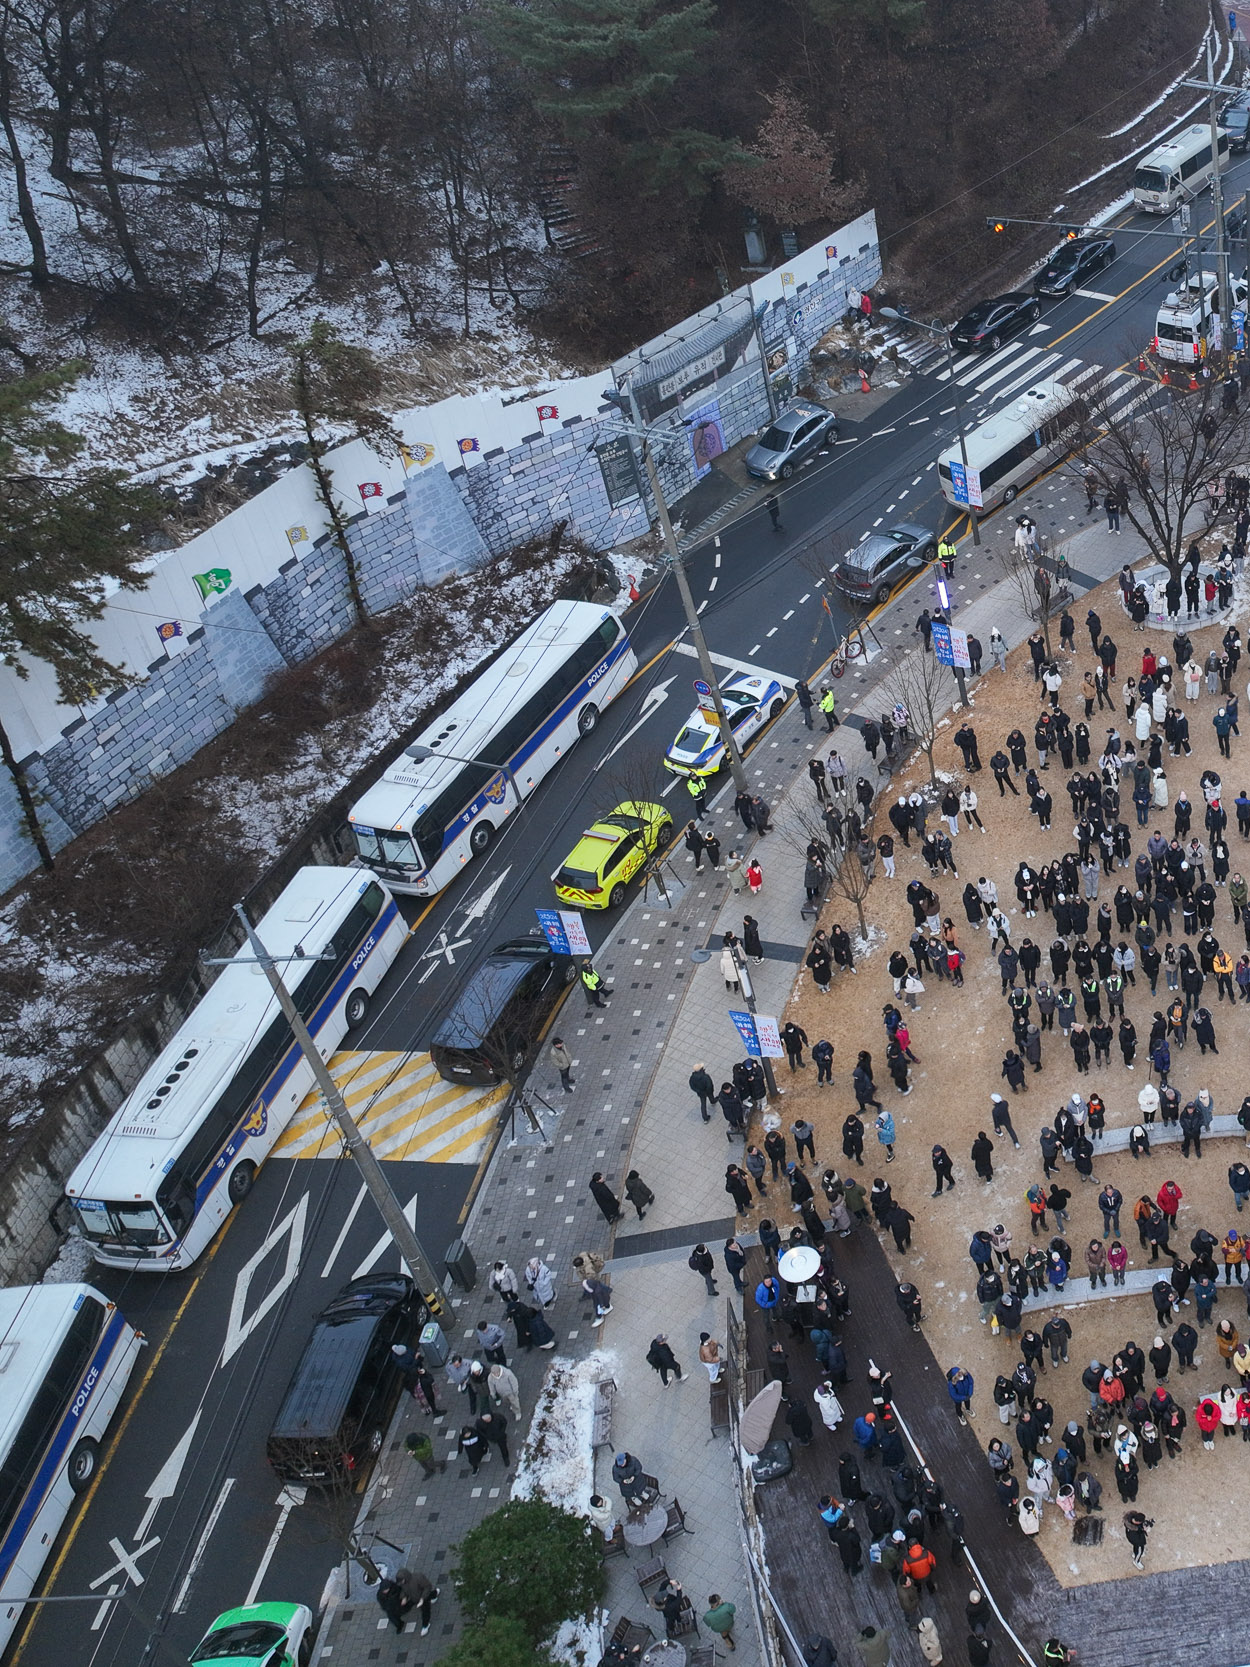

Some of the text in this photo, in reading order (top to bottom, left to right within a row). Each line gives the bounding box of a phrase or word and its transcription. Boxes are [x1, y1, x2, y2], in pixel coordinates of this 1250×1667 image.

[588, 662, 609, 687] POLICE
[353, 936, 375, 969] POLICE
[72, 1367, 98, 1416] POLICE
